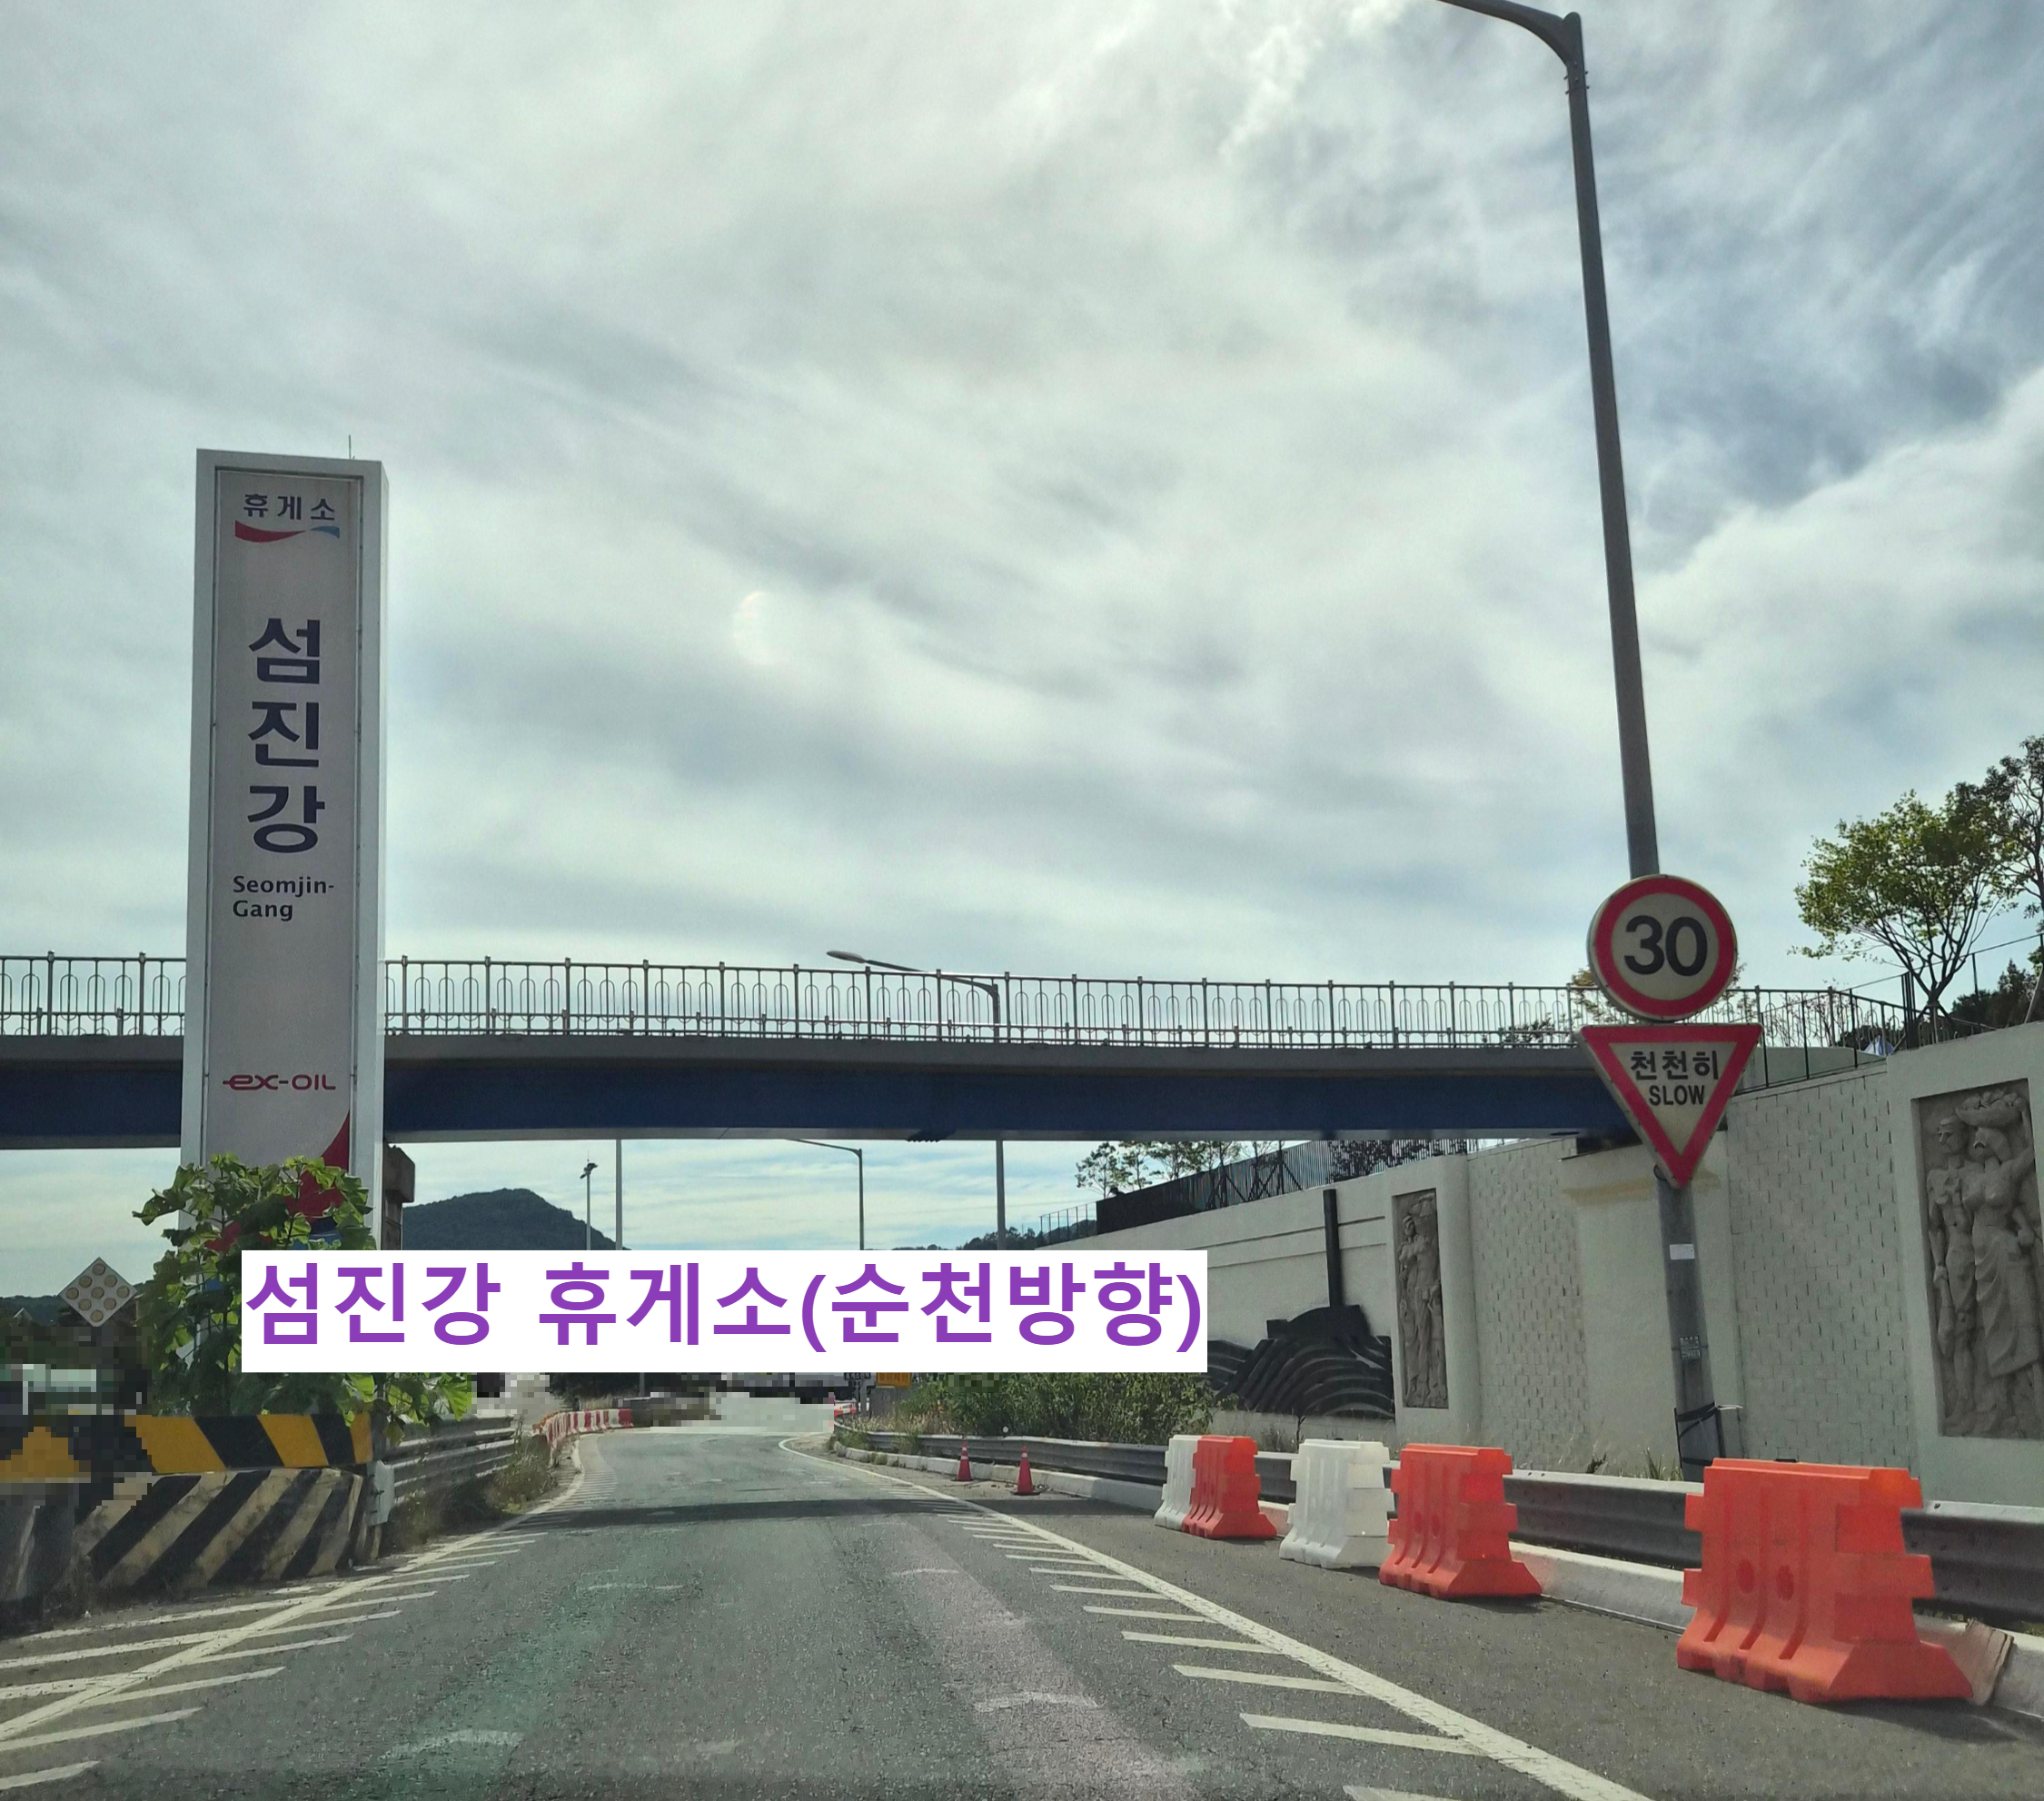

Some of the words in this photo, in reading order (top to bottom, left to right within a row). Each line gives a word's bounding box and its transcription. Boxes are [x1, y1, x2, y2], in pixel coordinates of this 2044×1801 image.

[243, 493, 335, 522] 휴게소
[247, 617, 326, 854] 섬진강
[233, 875, 334, 898] Seomjin-
[233, 900, 293, 921] Gang
[1623, 915, 1709, 977] 30
[1630, 1050, 1720, 1081] 천천히
[1648, 1084, 1705, 1107] SLOW
